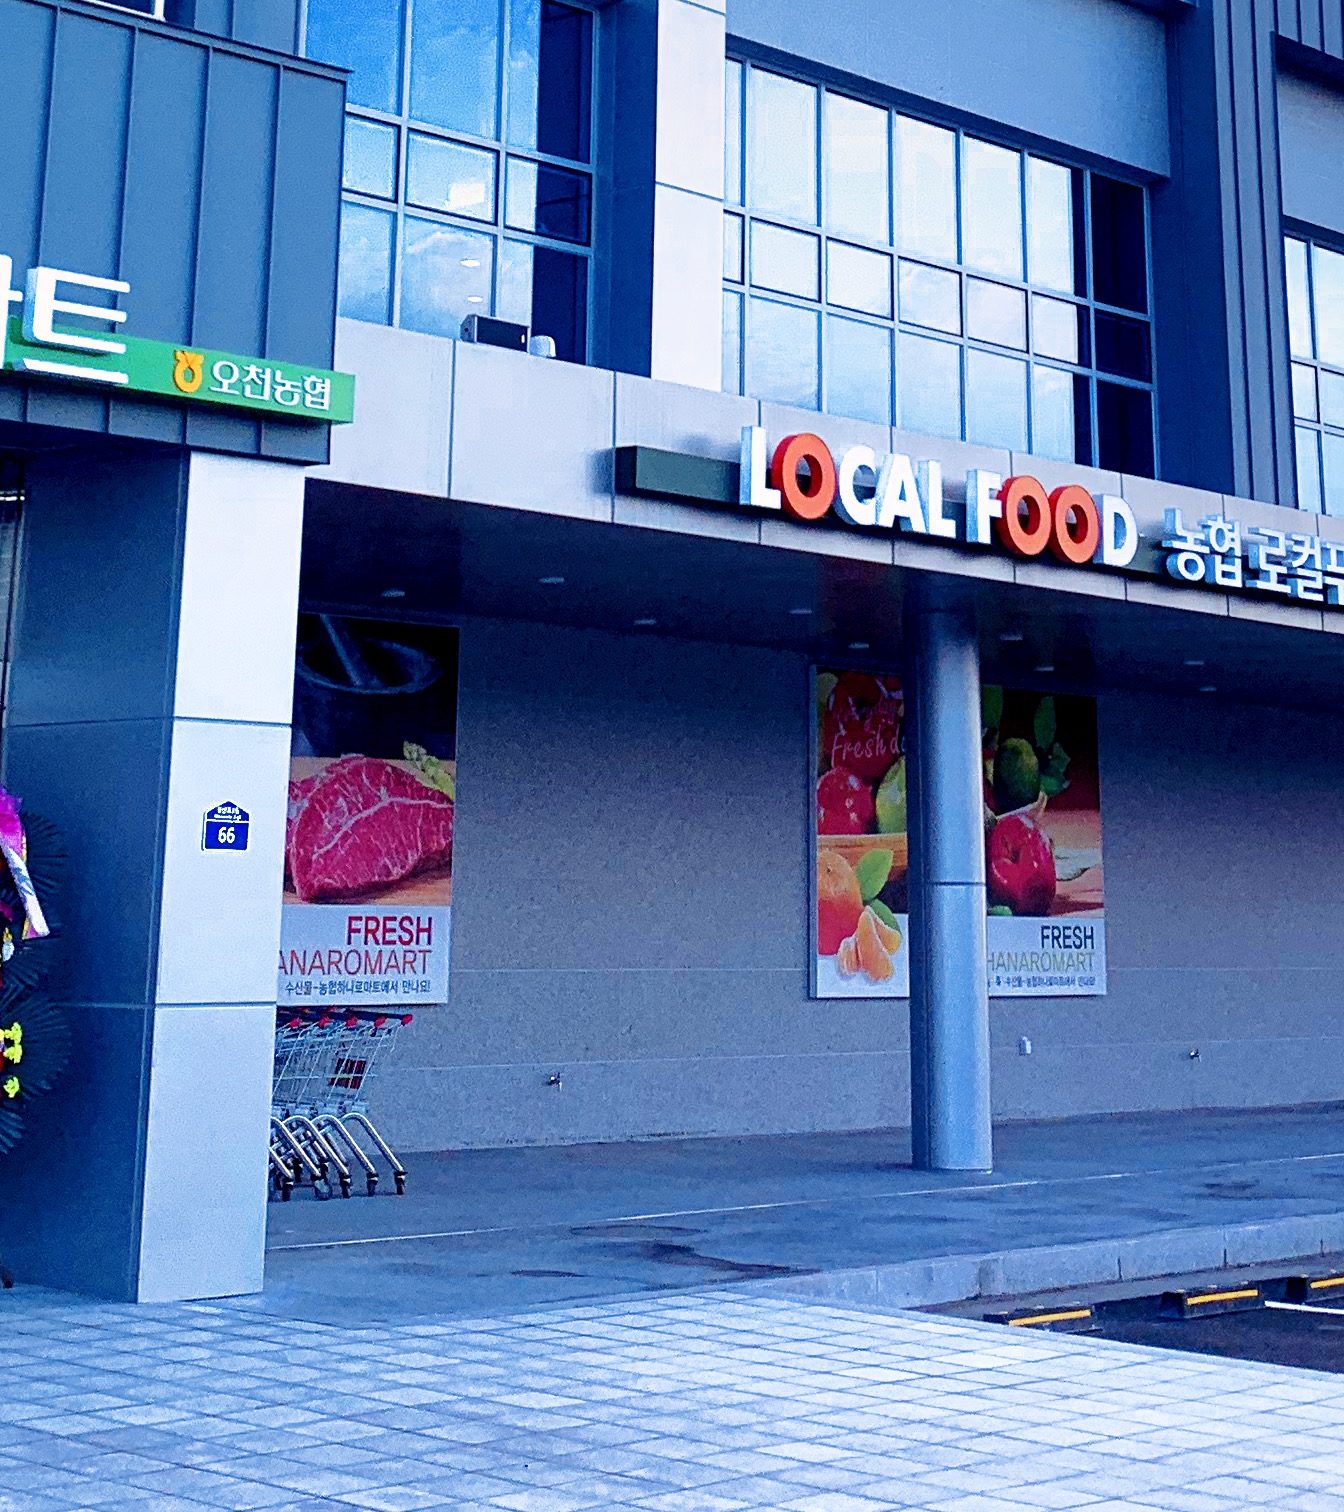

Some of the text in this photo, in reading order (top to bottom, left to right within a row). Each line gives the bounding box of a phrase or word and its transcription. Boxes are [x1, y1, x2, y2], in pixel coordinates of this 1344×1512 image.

[210, 360, 332, 411] 오천농협
[739, 425, 1139, 567] LOCAL FOOD
[1162, 507, 1244, 588] 농협
[217, 826, 236, 844] 66
[346, 915, 433, 946] FRESH
[1040, 925, 1095, 950] FRESH
